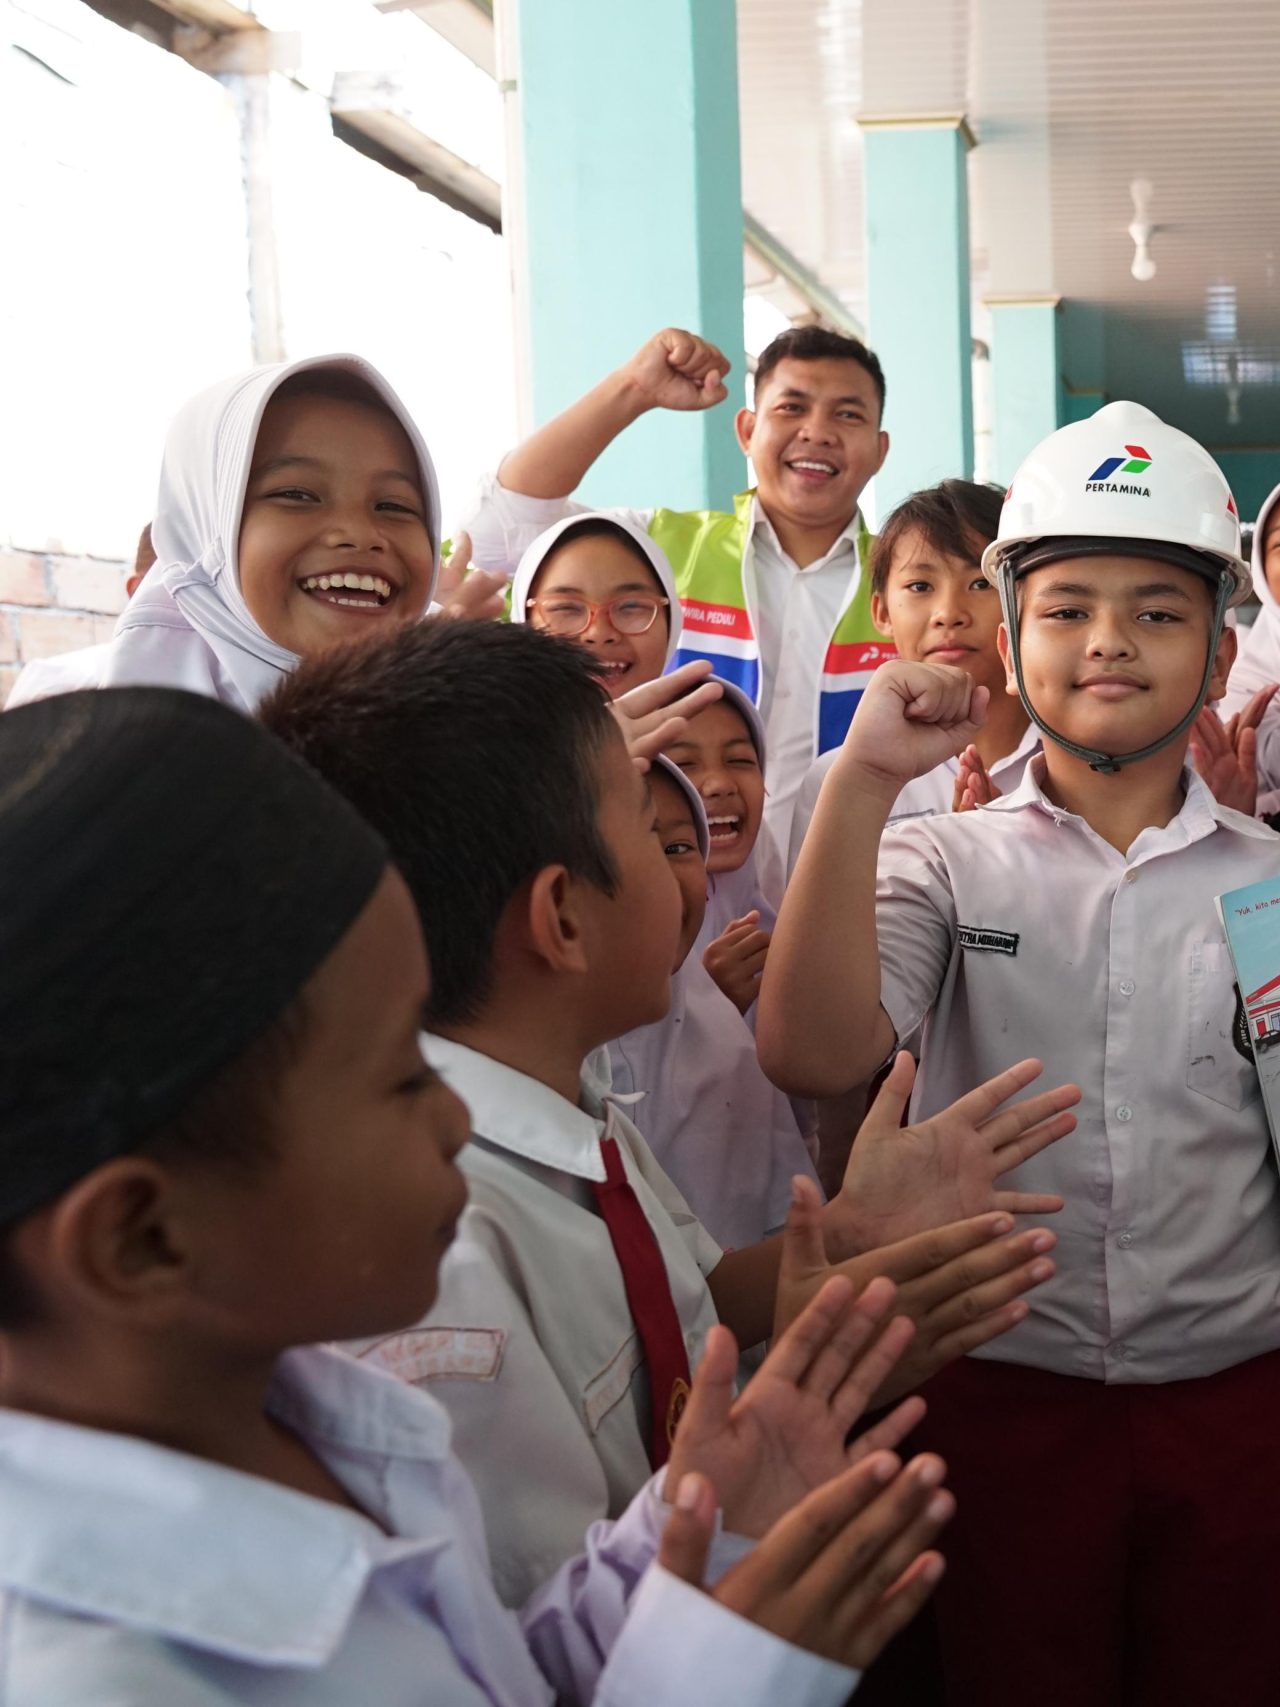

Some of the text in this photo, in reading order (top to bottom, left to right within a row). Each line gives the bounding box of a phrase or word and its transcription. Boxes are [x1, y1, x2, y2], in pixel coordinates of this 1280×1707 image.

[1085, 483, 1151, 497] PERTAMINA
[706, 610, 737, 626] PEDULI
[1255, 901, 1269, 910] kita
